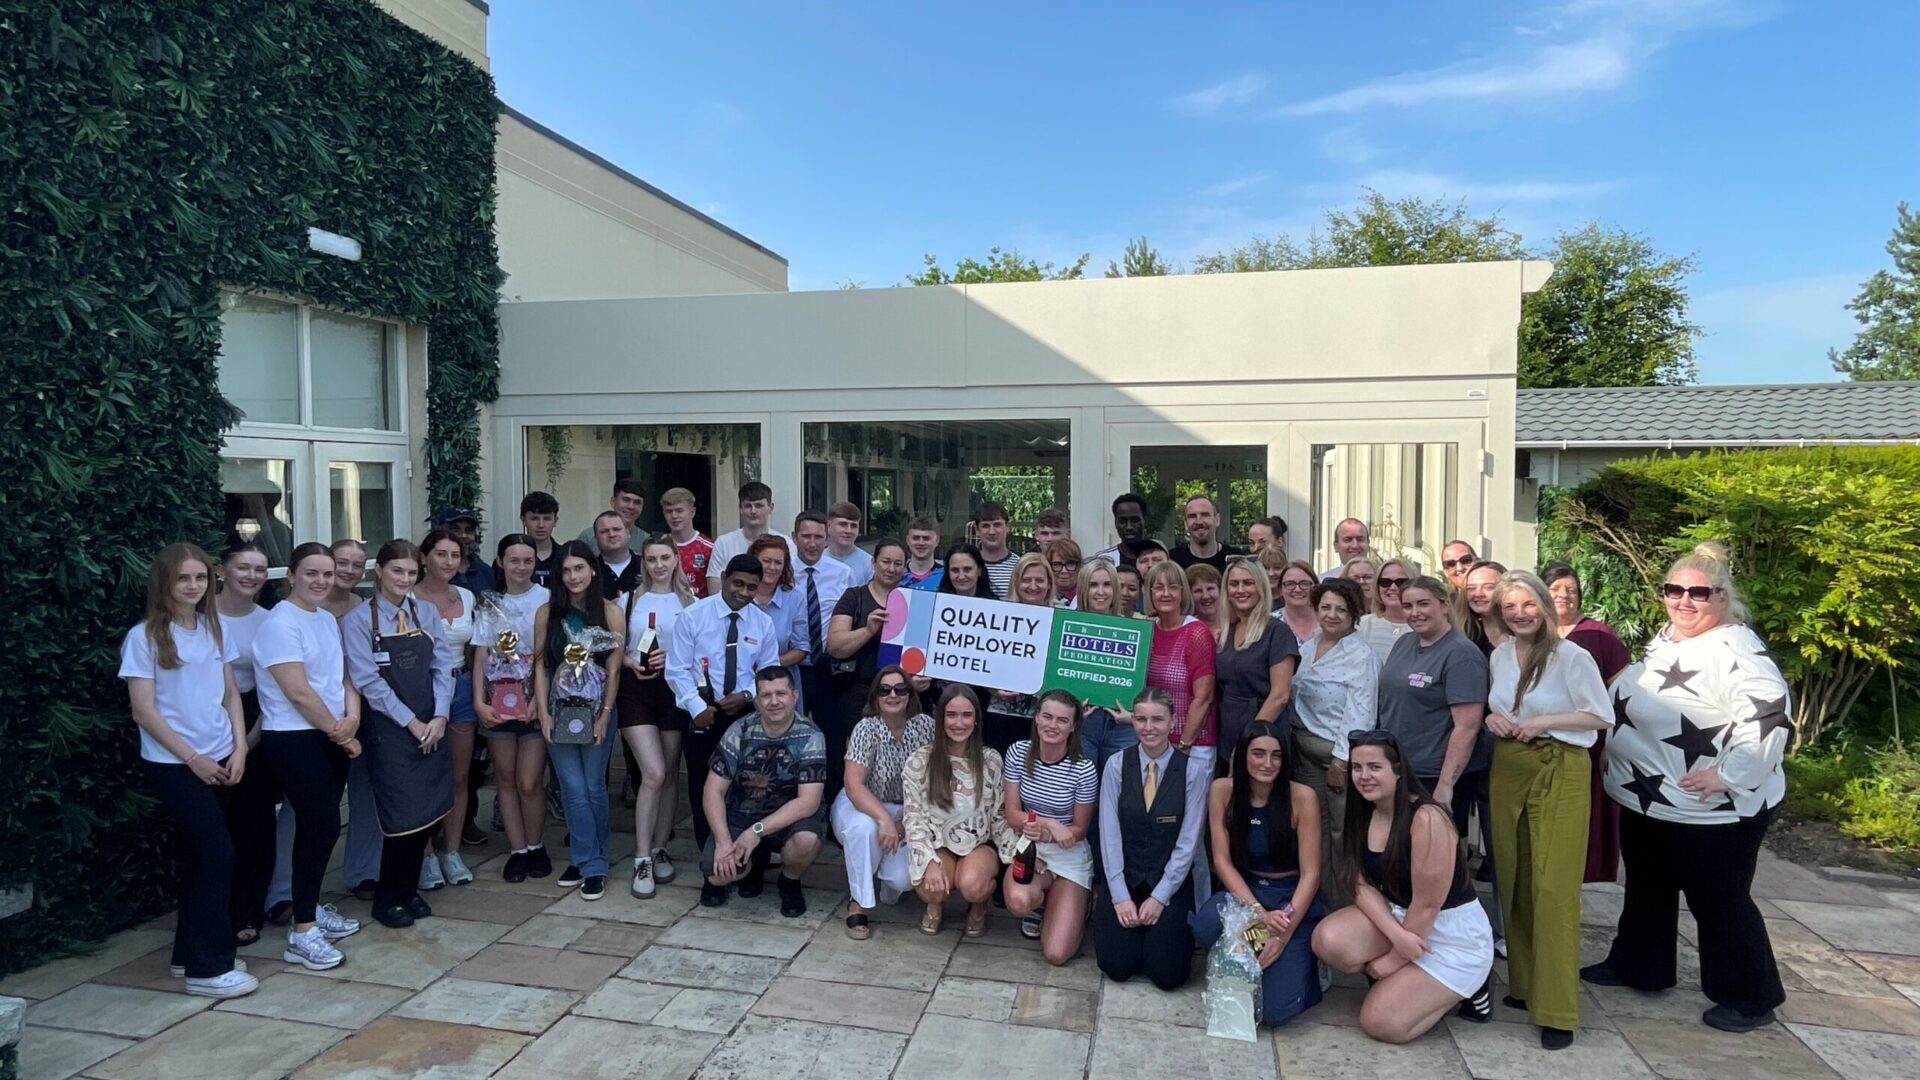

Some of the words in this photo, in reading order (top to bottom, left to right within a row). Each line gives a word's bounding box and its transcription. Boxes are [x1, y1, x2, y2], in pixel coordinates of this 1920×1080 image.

[940, 607, 1040, 636] QUALITY
[1067, 624, 1136, 640] IRISH
[936, 630, 1036, 659] EMPLOYER
[1064, 635, 1134, 656] HOTELS
[933, 652, 991, 674] HOTEL
[1064, 650, 1132, 667] FEDERATION
[1056, 668, 1106, 683] CERTIFIED
[1108, 676, 1133, 688] 2026
